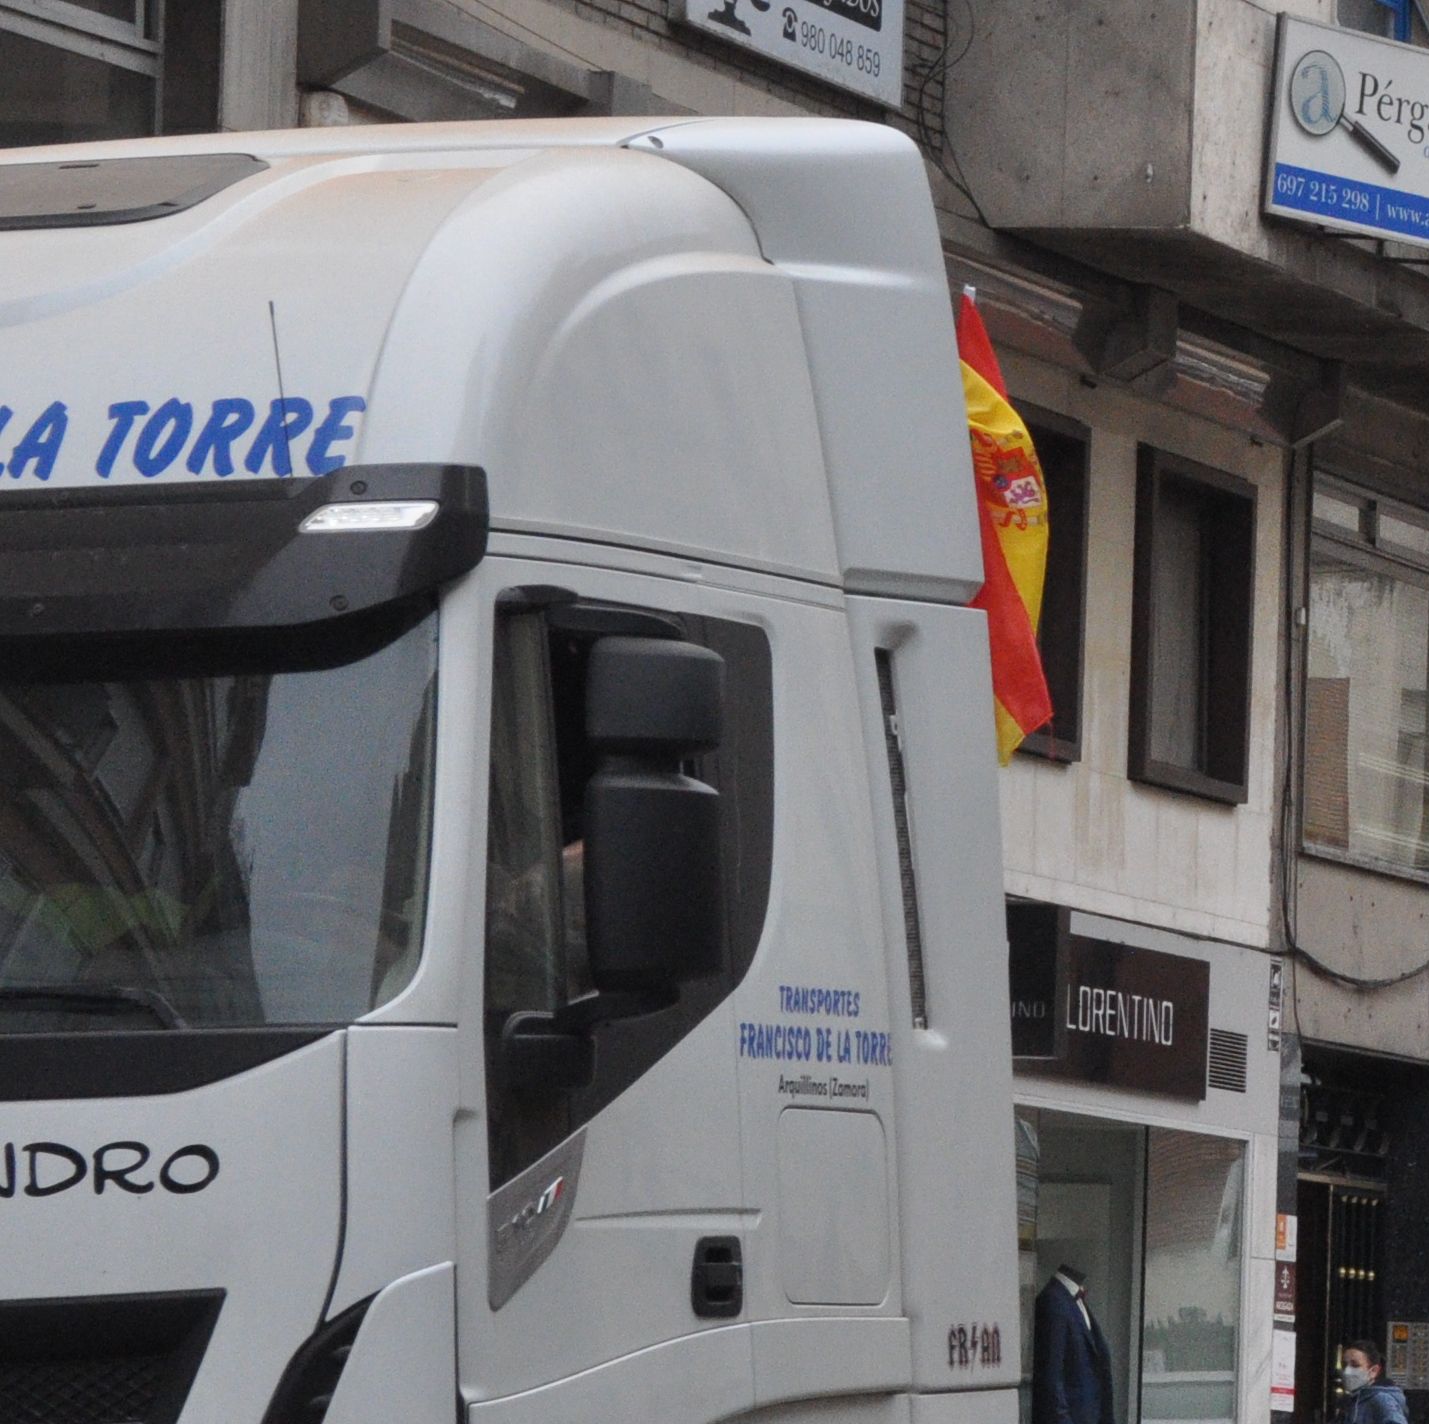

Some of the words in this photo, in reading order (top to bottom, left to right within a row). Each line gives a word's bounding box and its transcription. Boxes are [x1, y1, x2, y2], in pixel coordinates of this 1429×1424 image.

[801, 21, 825, 54] 980
[829, 33, 853, 66] 048
[857, 45, 880, 77] 859
[1277, 173, 1305, 197] 697
[1309, 181, 1337, 205] 215
[1342, 187, 1370, 212] 298
[96, 396, 367, 478] TORRE
[778, 985, 861, 1018] TRANSPORTES
[739, 1023, 812, 1062] FRANCISCO
[815, 1027, 833, 1063] DE
[837, 1030, 852, 1064] LA
[855, 1031, 894, 1067] TORRE
[777, 1073, 828, 1099] Arquillinos
[829, 1077, 870, 1102] (Zamora)
